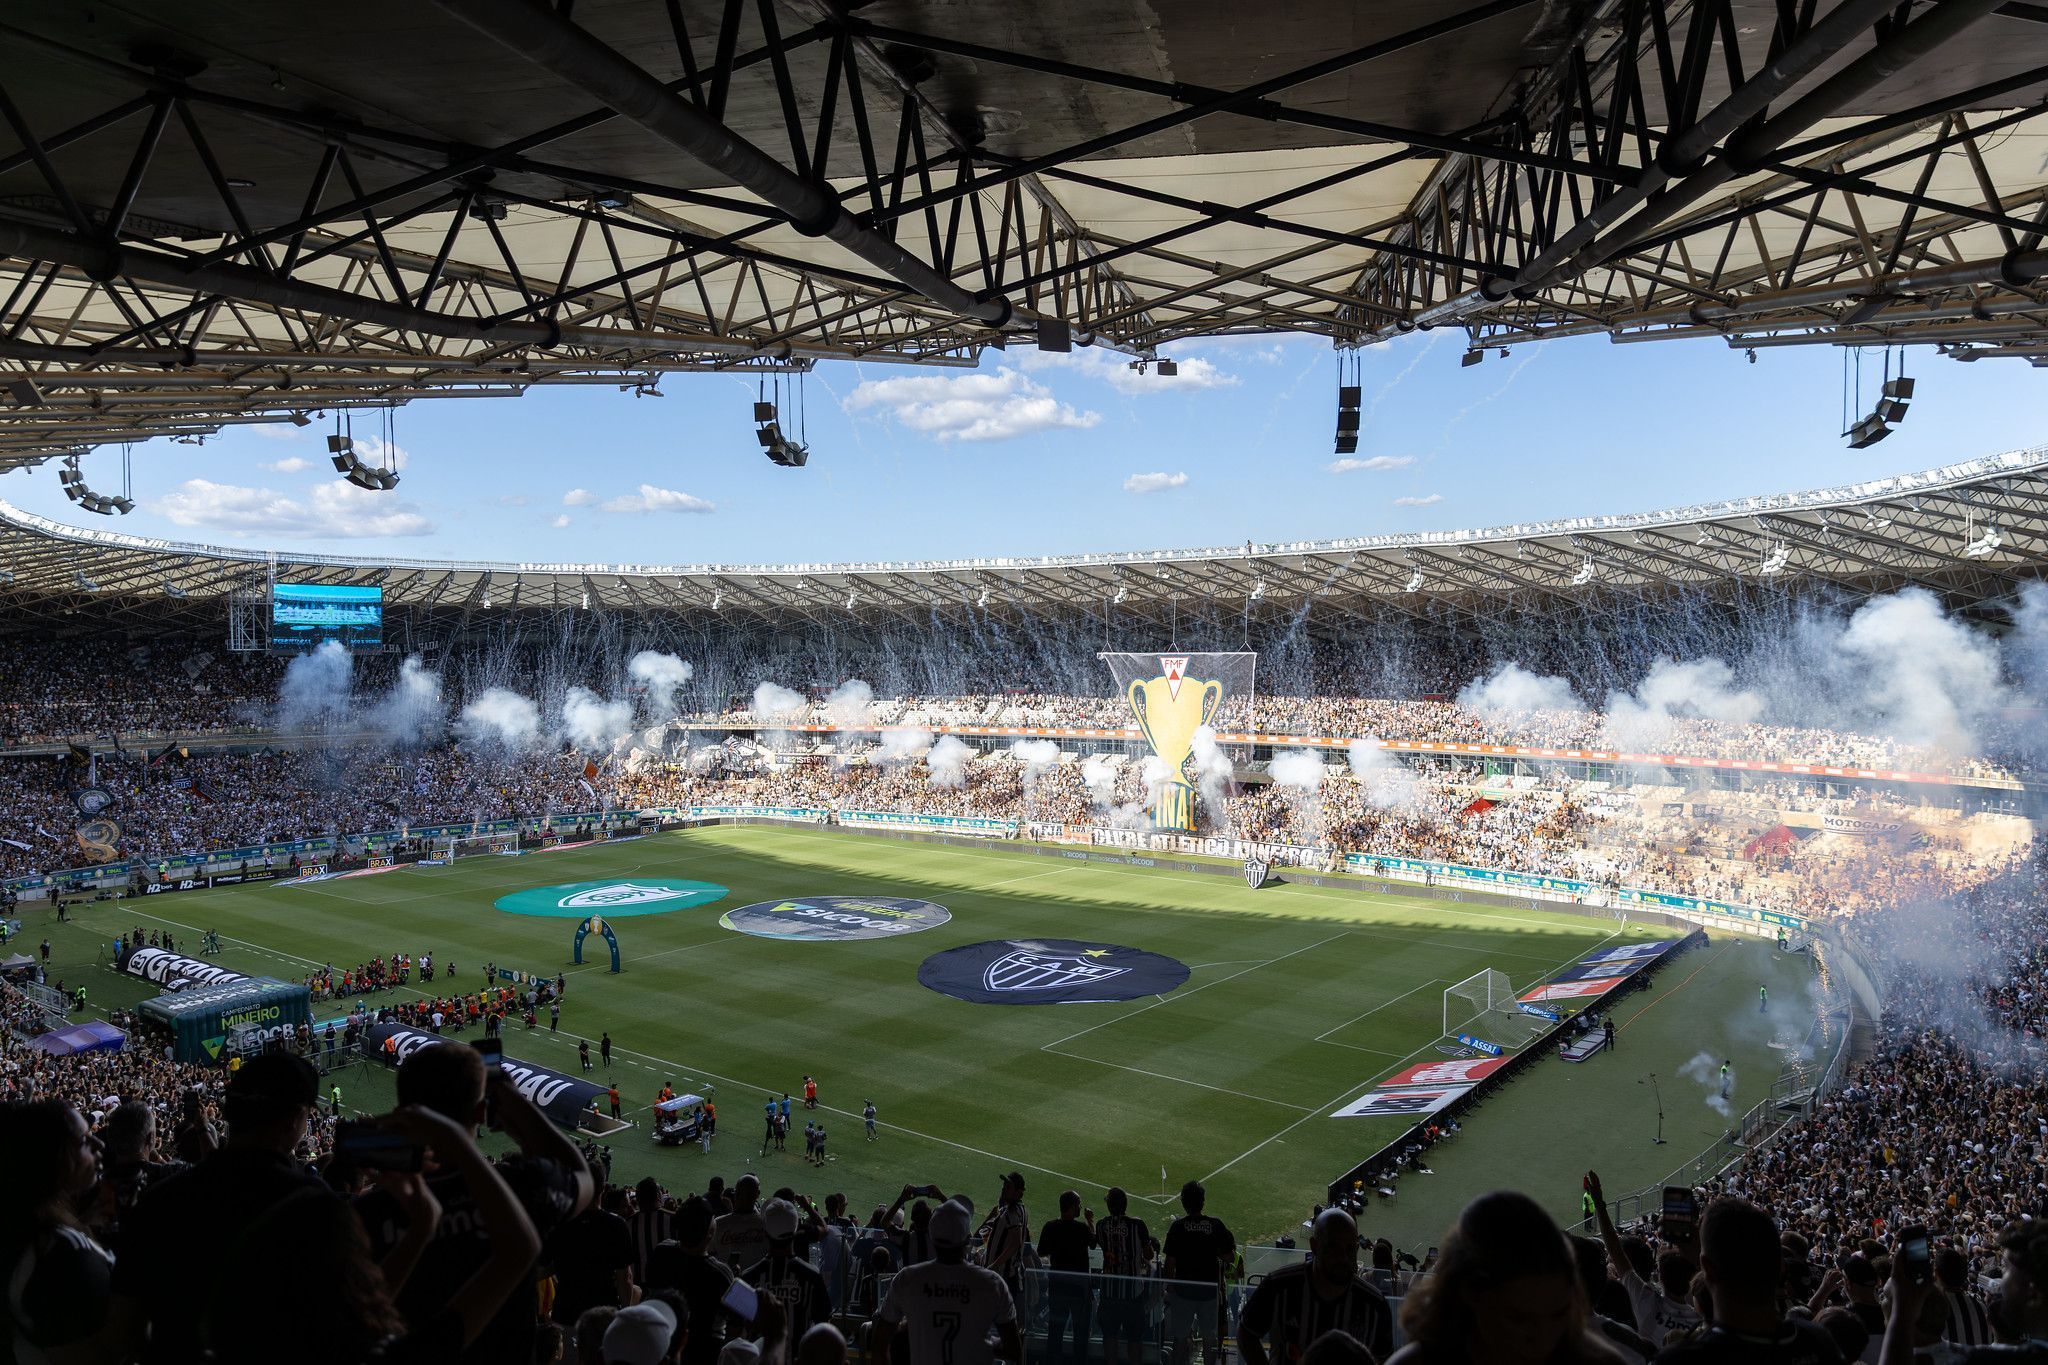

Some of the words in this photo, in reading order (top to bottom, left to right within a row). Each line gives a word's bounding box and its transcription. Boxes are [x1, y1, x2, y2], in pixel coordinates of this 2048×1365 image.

[1165, 659, 1184, 668] FMF
[1824, 817, 1899, 831] MOTOGALO
[544, 837, 563, 846] BRAX
[370, 858, 392, 868] BRAX
[302, 866, 326, 876] BRAX
[794, 908, 912, 932] SICOOB
[1019, 956, 1099, 975] CAM
[221, 1003, 261, 1017] CAMPEONATO
[221, 1005, 280, 1031] MINEIRO
[932, 1311, 962, 1365] 7
